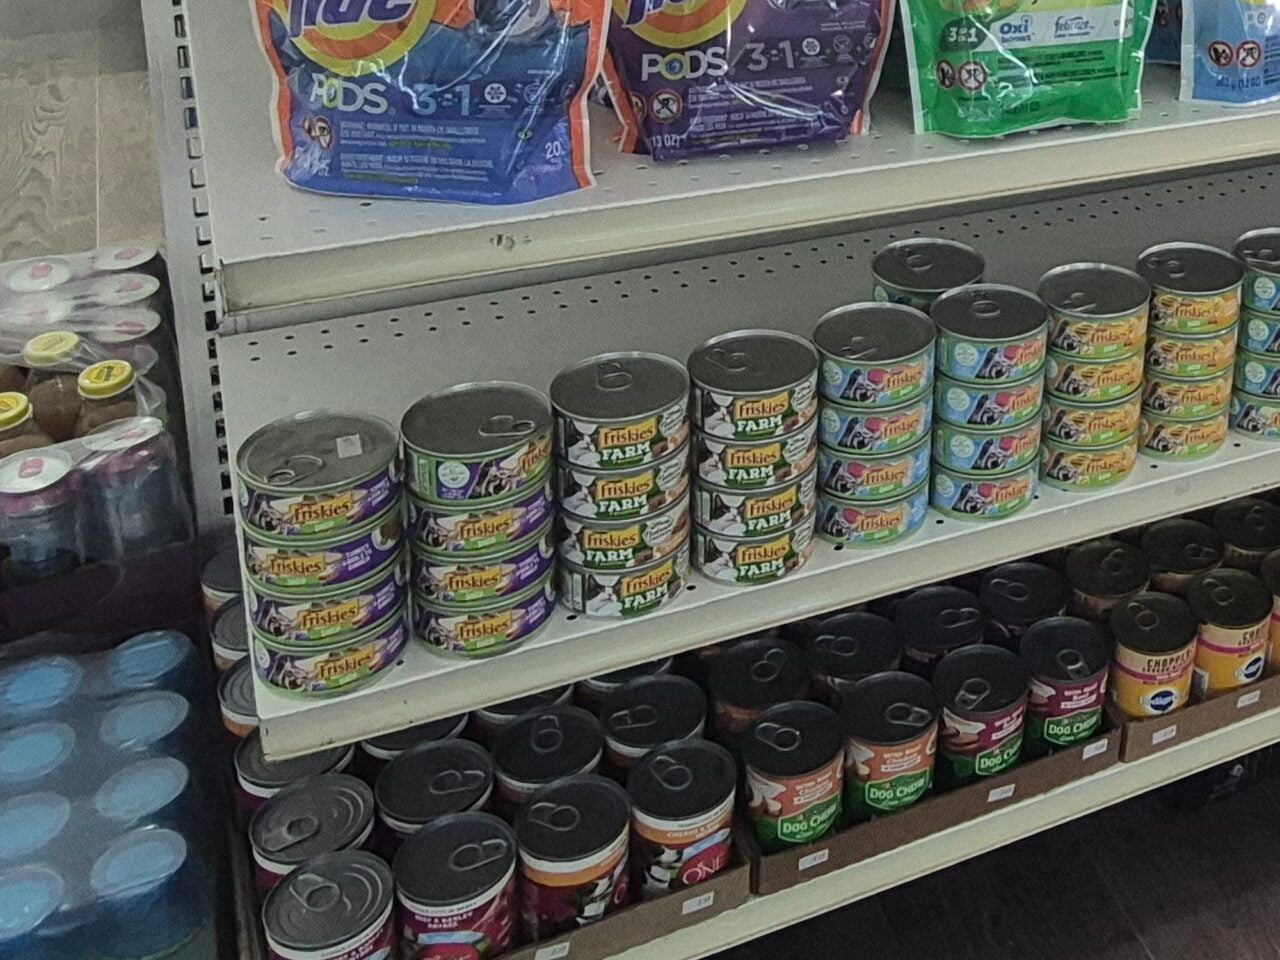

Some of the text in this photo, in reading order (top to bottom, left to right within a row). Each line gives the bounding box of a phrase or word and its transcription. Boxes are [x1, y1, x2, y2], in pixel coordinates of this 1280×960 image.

[641, 46, 729, 81] PODS
[738, 400, 787, 416] Friskies
[736, 414, 783, 433] FARM
[602, 427, 654, 446] Friskies
[601, 441, 650, 460] FARM
[730, 451, 777, 464] Friskies
[727, 465, 774, 482] FARM
[600, 480, 650, 498] Friskies
[294, 500, 350, 524] Friskies
[599, 493, 648, 512] FARM
[750, 494, 795, 513] Friskies
[459, 517, 511, 539] Friskies
[747, 511, 791, 532] FARM
[860, 514, 901, 531] Friskies
[587, 532, 637, 548] Friskies
[586, 548, 633, 565] FARM
[741, 544, 787, 563] Friskies
[269, 559, 322, 575] Friskies
[739, 559, 784, 578] FARM
[448, 574, 500, 589] Friskies
[625, 570, 671, 592] Friskies
[624, 584, 670, 609] FARM
[302, 606, 357, 628] Friskies
[459, 619, 509, 640] Friskies
[319, 652, 374, 676] Friskies
[1047, 714, 1098, 736] DOG CHOW
[979, 754, 999, 771] DOG
[869, 777, 925, 800] DOG CHOW
[782, 803, 839, 835] DOG CHOW
[682, 853, 725, 885] ONE
